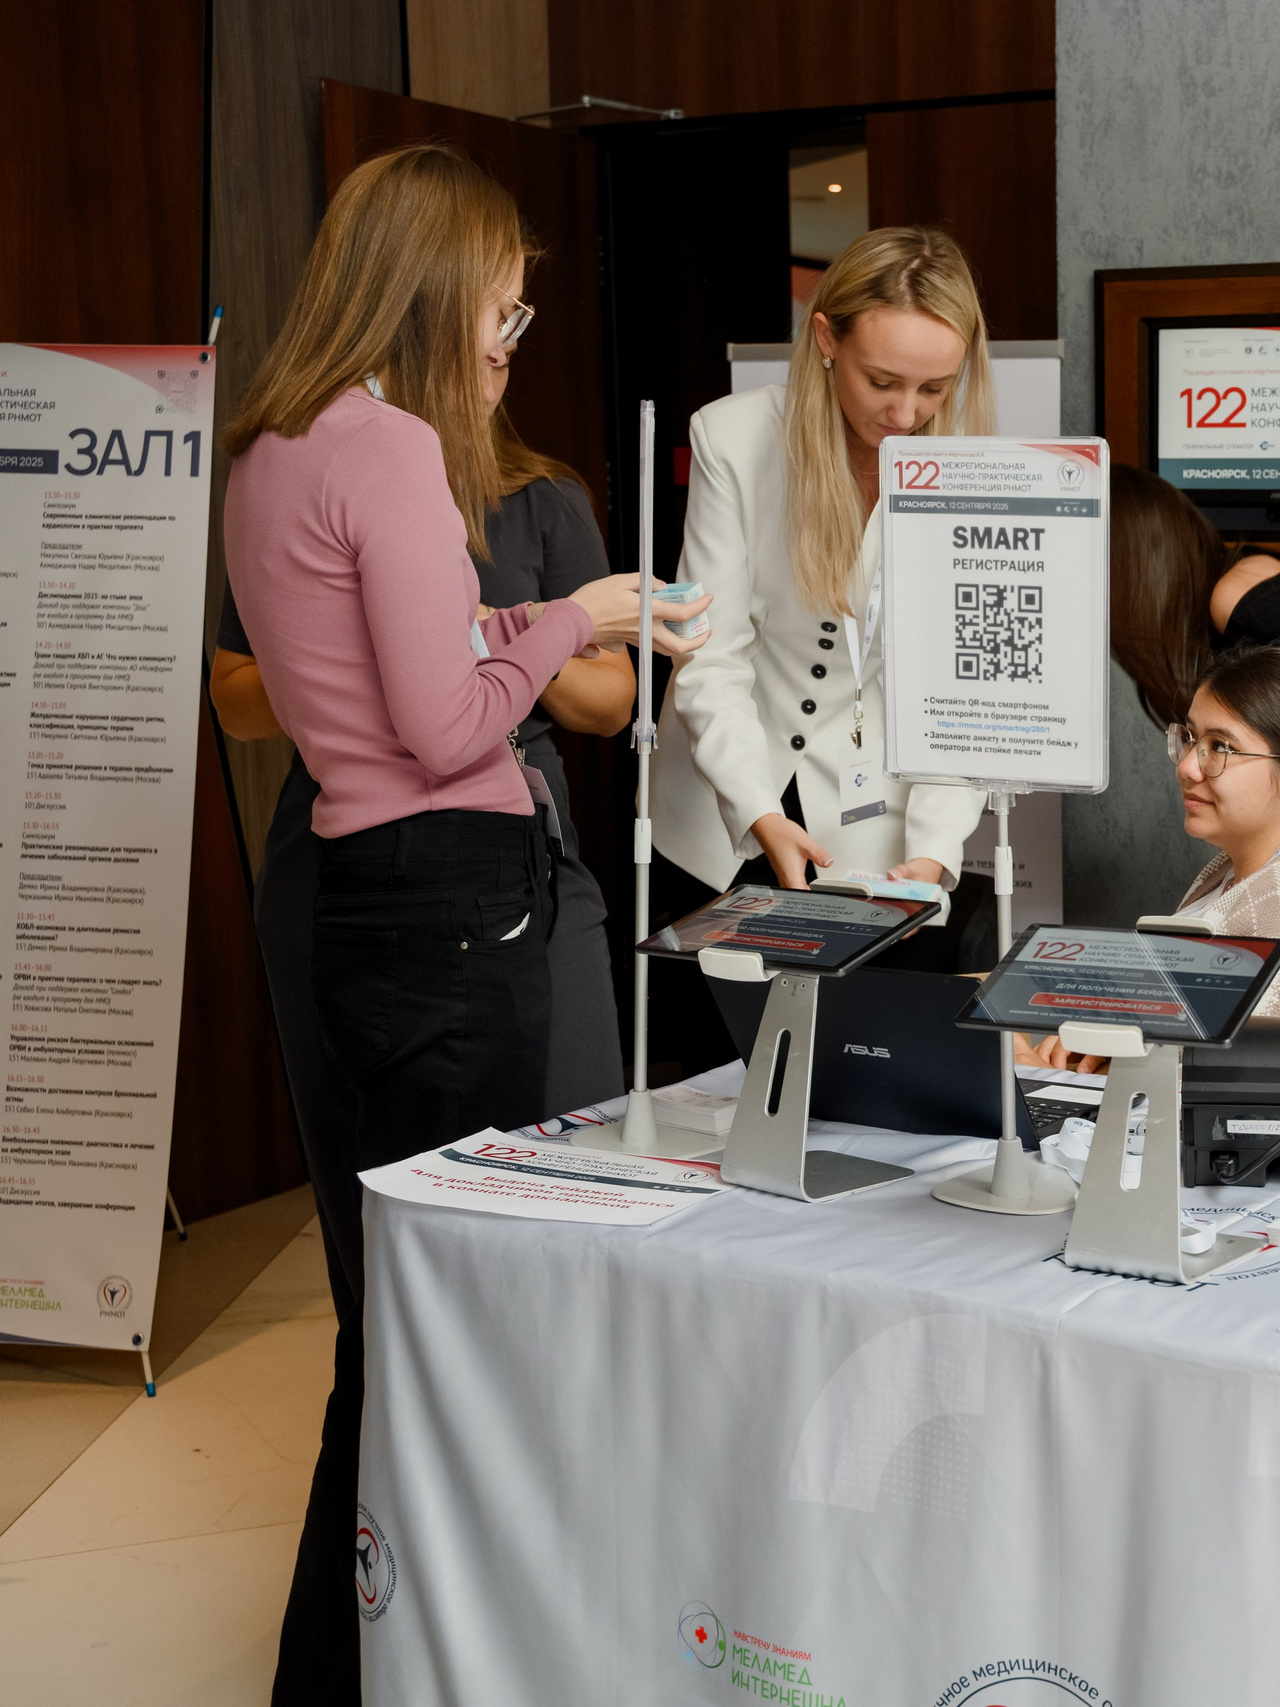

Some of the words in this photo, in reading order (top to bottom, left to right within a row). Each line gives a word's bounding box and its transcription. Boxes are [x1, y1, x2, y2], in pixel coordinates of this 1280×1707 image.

[1180, 387, 1246, 428] 122
[8, 414, 42, 422] РНМОТ
[64, 428, 173, 477] ЗАЛ
[183, 431, 201, 477] 1
[20, 457, 43, 467] 2025
[942, 462, 1025, 470] МЕЖРЕГИОНАЛЬНАЯ
[894, 460, 940, 490] 122
[942, 473, 1042, 481] НАУЧНО-ПРАКТИЧЕСКАЯ
[1183, 469, 1250, 479] КРАСНОЯРСК,
[1252, 469, 1261, 478] 12
[943, 484, 1001, 492] КОНФЕРЕНЦИЯ
[899, 501, 947, 509] КРАСНОЯРСК,
[953, 525, 1045, 551] SMART
[953, 558, 1045, 574] РЕГИСТРАЦИЯ
[930, 697, 966, 706] Считайте
[968, 699, 996, 708] QR-код
[998, 702, 1049, 710] смартфоном
[991, 713, 1027, 721] браузере
[1030, 716, 1066, 724] страницу
[930, 732, 971, 740] Заполните
[973, 735, 999, 743] анкету
[1009, 738, 1044, 746] получите
[1046, 738, 1072, 748] бейдж
[930, 744, 970, 752] оператора
[985, 746, 1011, 754] стойке
[1014, 748, 1041, 756] печати
[726, 897, 773, 911] 122
[1032, 942, 1085, 961] 122
[1023, 965, 1076, 973] КРАСНОЯРСК,
[1079, 957, 1145, 966] КОНФЕРЕНЦИЯ
[1078, 984, 1136, 994] ПОЛУЧЕНИЯ
[1052, 997, 1162, 1010] ЗАРЕГИСТРИРОВАТЬСЯ
[844, 1044, 891, 1058] ASUS
[473, 1144, 537, 1161] 122
[526, 1160, 601, 1175] КОНФЕРЕНЦИЯ
[601, 1170, 638, 1178] РНМОТ
[533, 1156, 658, 1176] НАУЧНО-ПРАКТИЧЕСКАЯ
[540, 1153, 644, 1169] МЕЖРЕГИОНАЛЬНАЯ
[411, 1168, 443, 1180] для
[444, 1178, 554, 1194] докладчиков
[557, 1191, 675, 1208] производится
[483, 1176, 545, 1188] Выдача
[550, 1184, 625, 1198] бейджей
[448, 1186, 516, 1196] комнате
[518, 1194, 630, 1209] докладчиков
[734, 1629, 771, 1650] НАВСТРЕЧУ
[772, 1644, 812, 1661] ЗНАНИЯМ
[732, 1644, 813, 1686] МЕЛАМЕД
[972, 1658, 1099, 1700] медицинское
